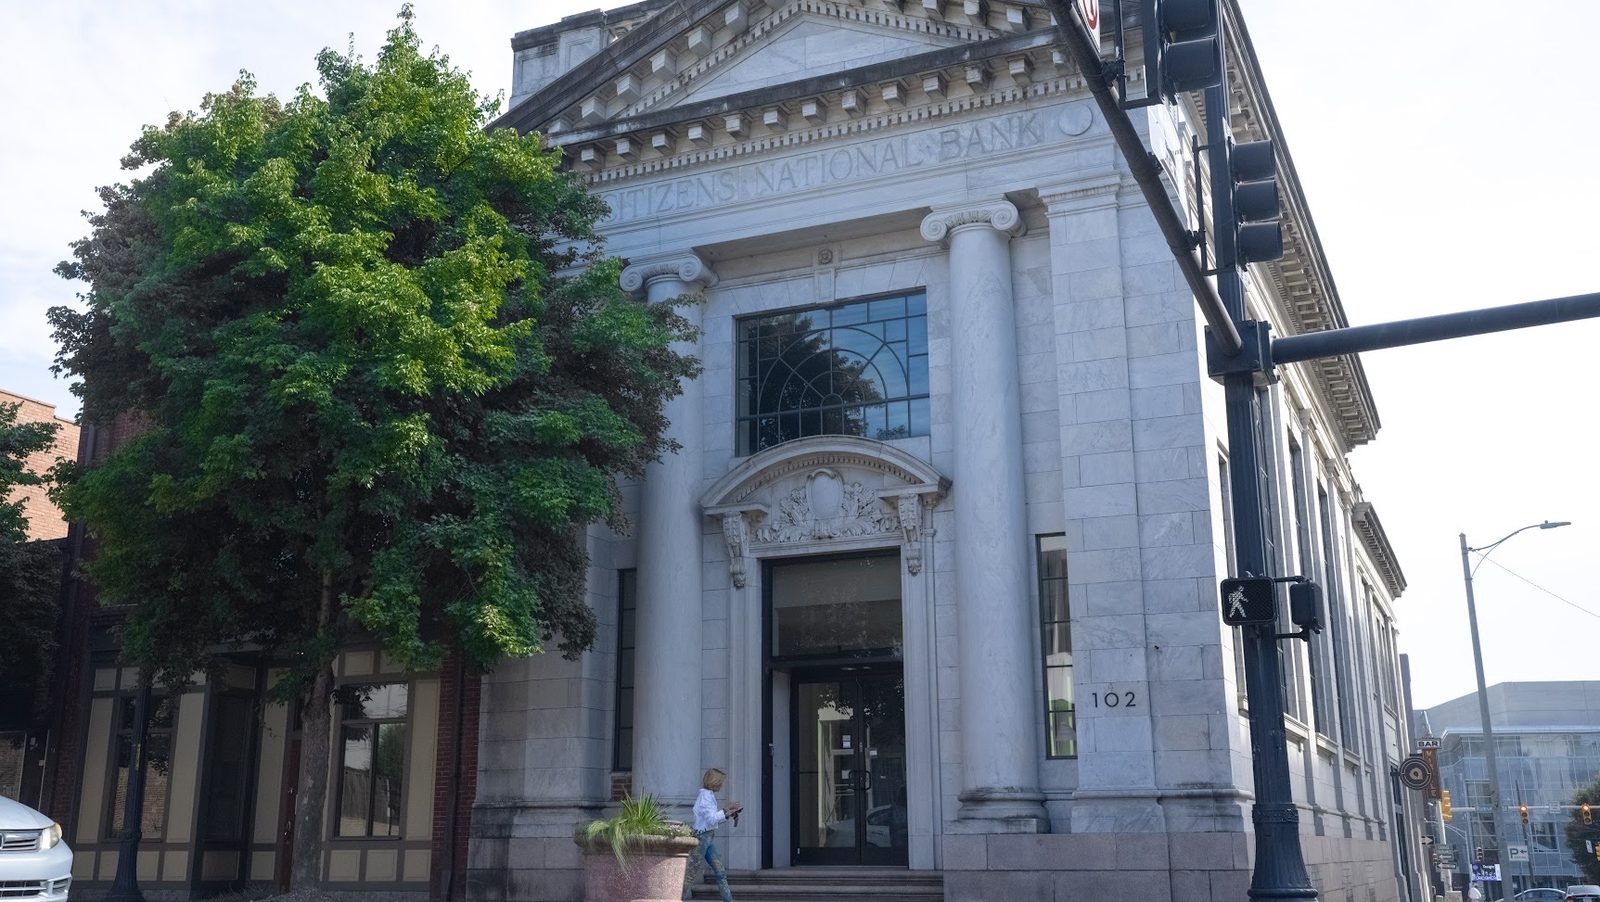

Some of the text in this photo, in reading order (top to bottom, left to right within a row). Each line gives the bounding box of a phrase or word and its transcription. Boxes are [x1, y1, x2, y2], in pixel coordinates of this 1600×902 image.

[601, 112, 1042, 223] CITIZENS NATIONAL BANK
[1091, 691, 1137, 708] 102
